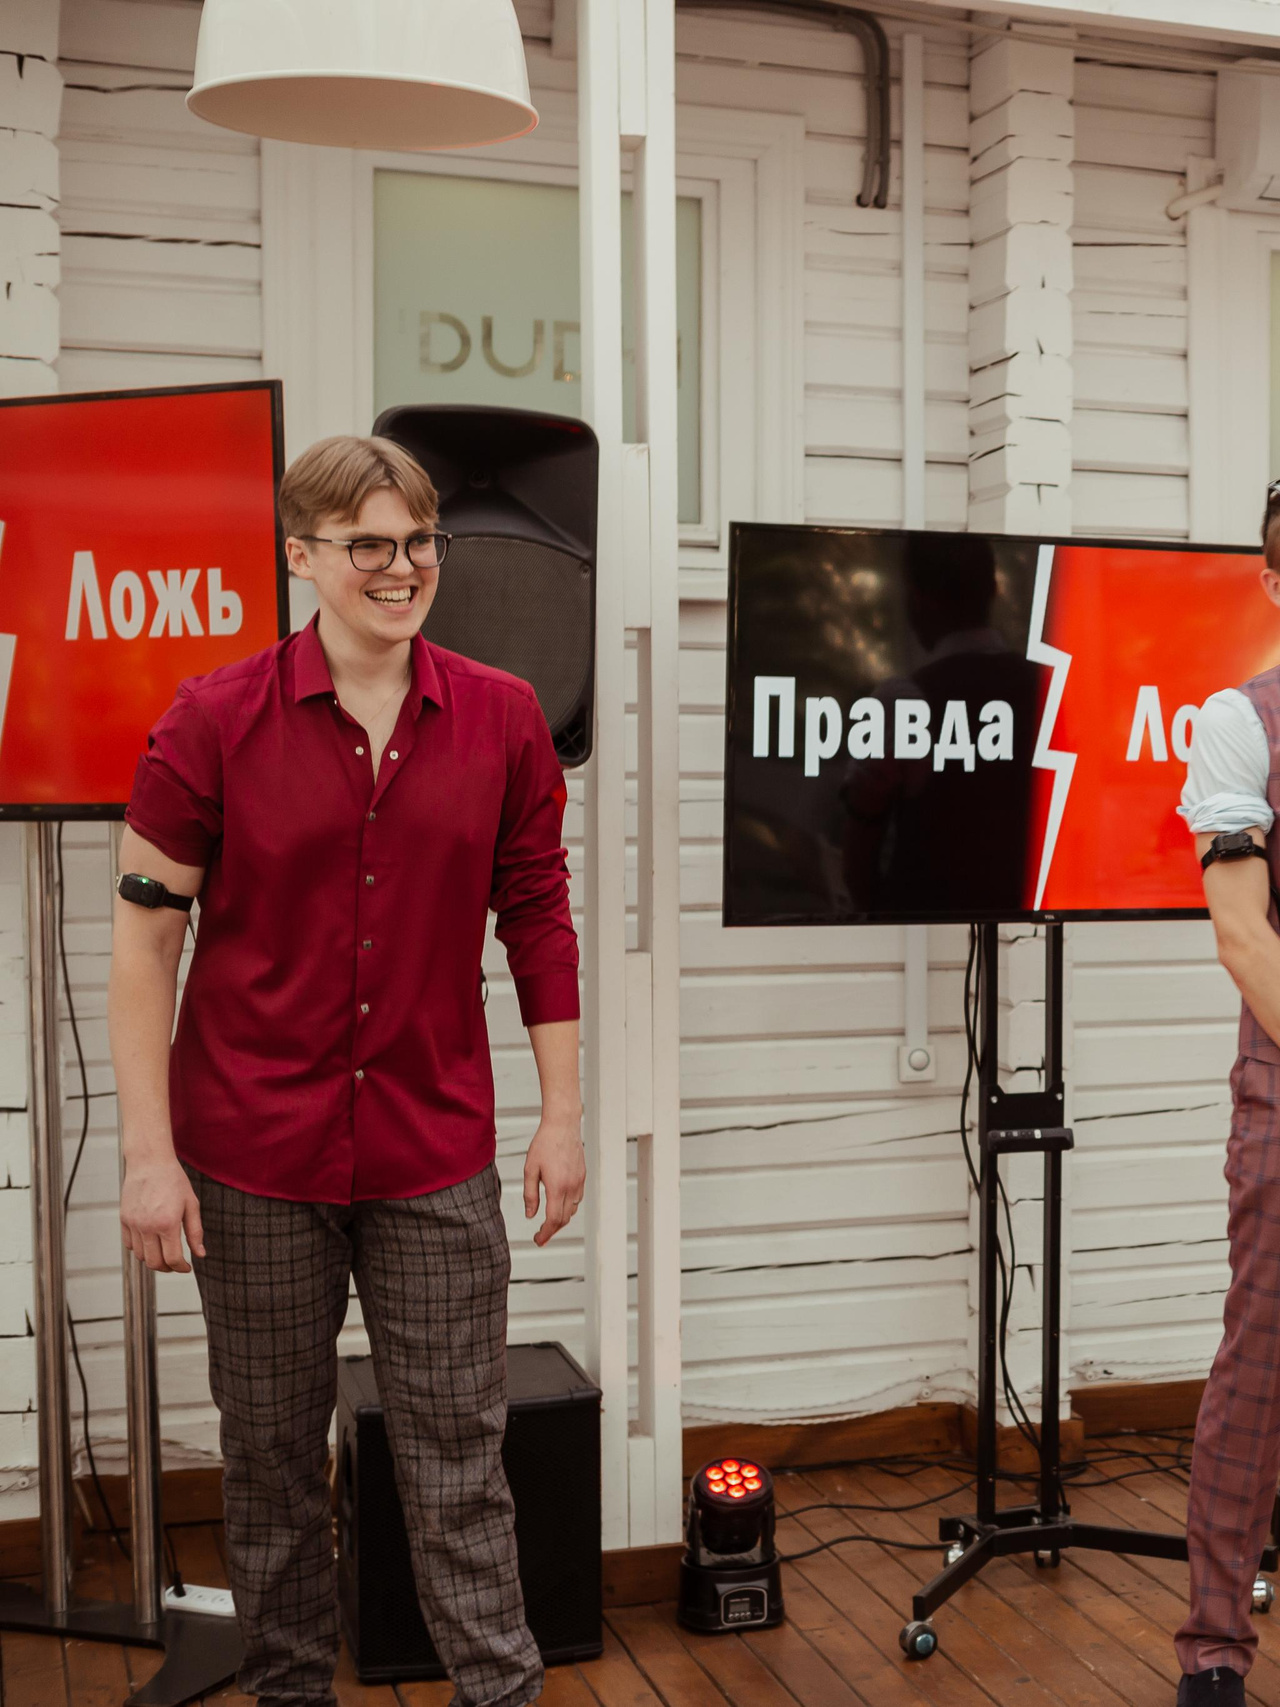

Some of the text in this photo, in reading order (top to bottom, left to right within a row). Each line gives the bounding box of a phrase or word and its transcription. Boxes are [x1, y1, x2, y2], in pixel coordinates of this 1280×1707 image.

[65, 550, 243, 641] Ложь
[753, 675, 1201, 777] Правда Ло
